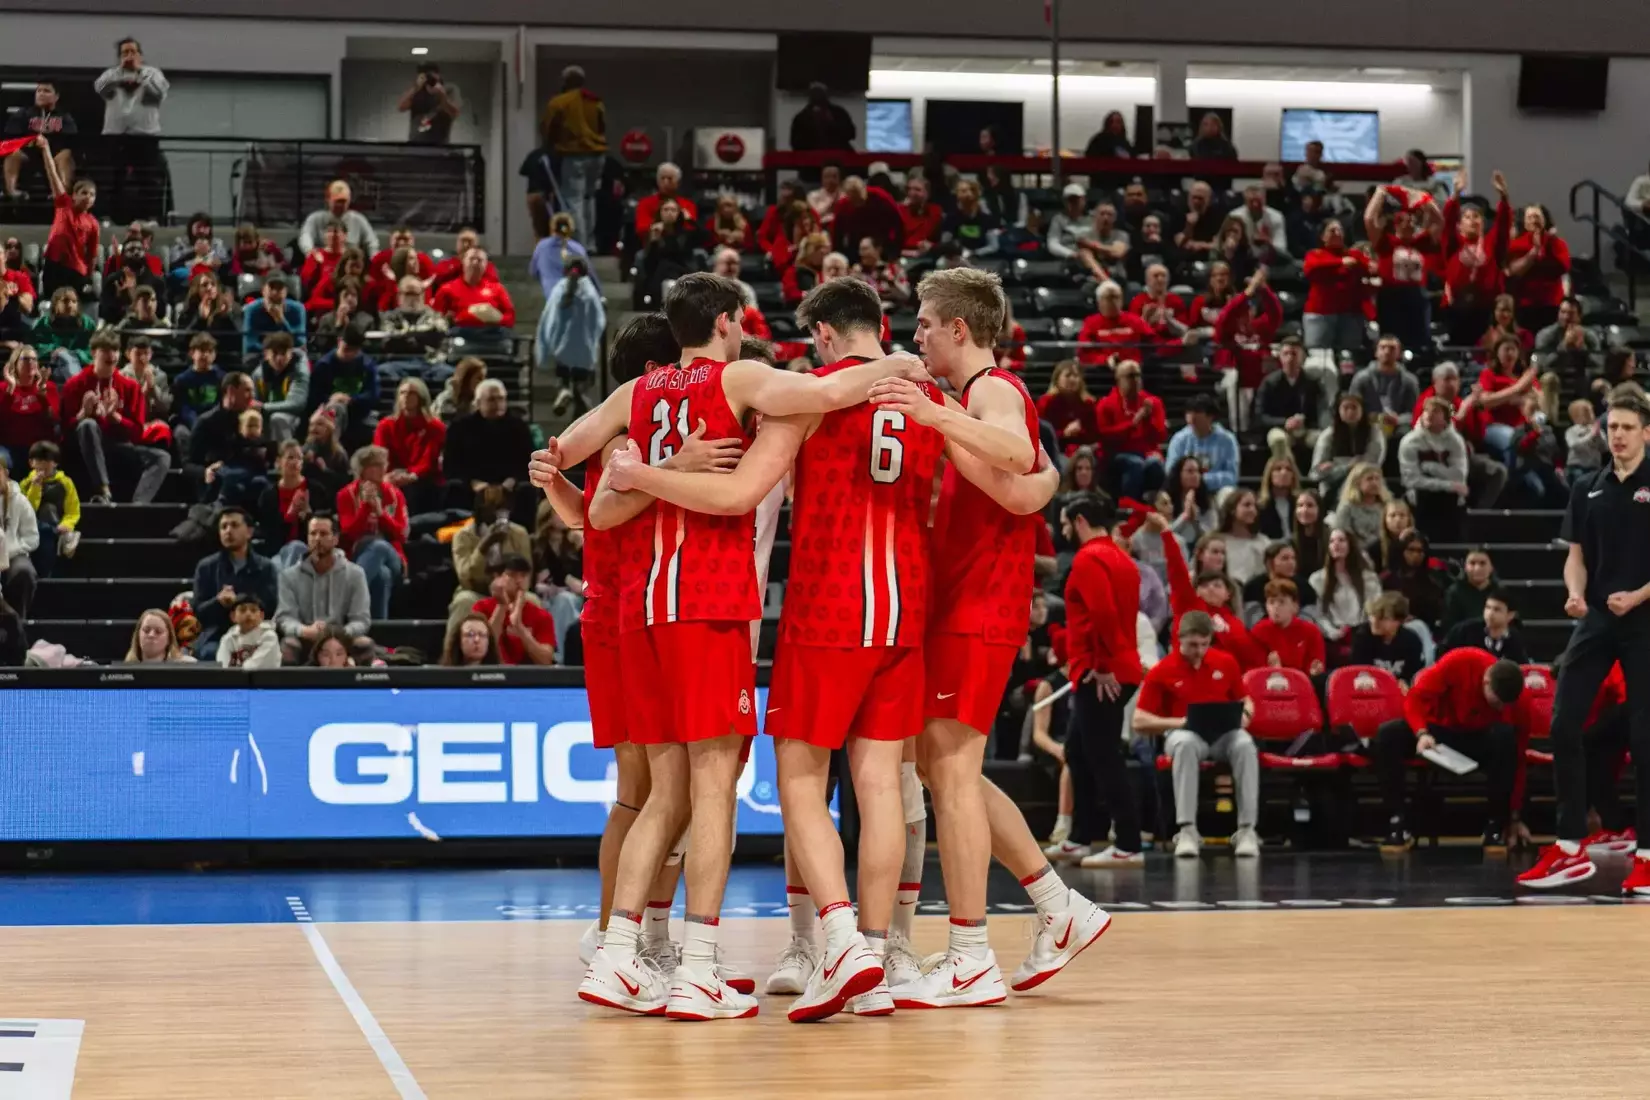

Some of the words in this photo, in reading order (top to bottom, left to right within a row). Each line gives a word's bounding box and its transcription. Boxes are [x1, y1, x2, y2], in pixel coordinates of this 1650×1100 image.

[649, 397, 691, 467] 21
[869, 408, 906, 484] 6
[308, 722, 757, 804] GEIC
